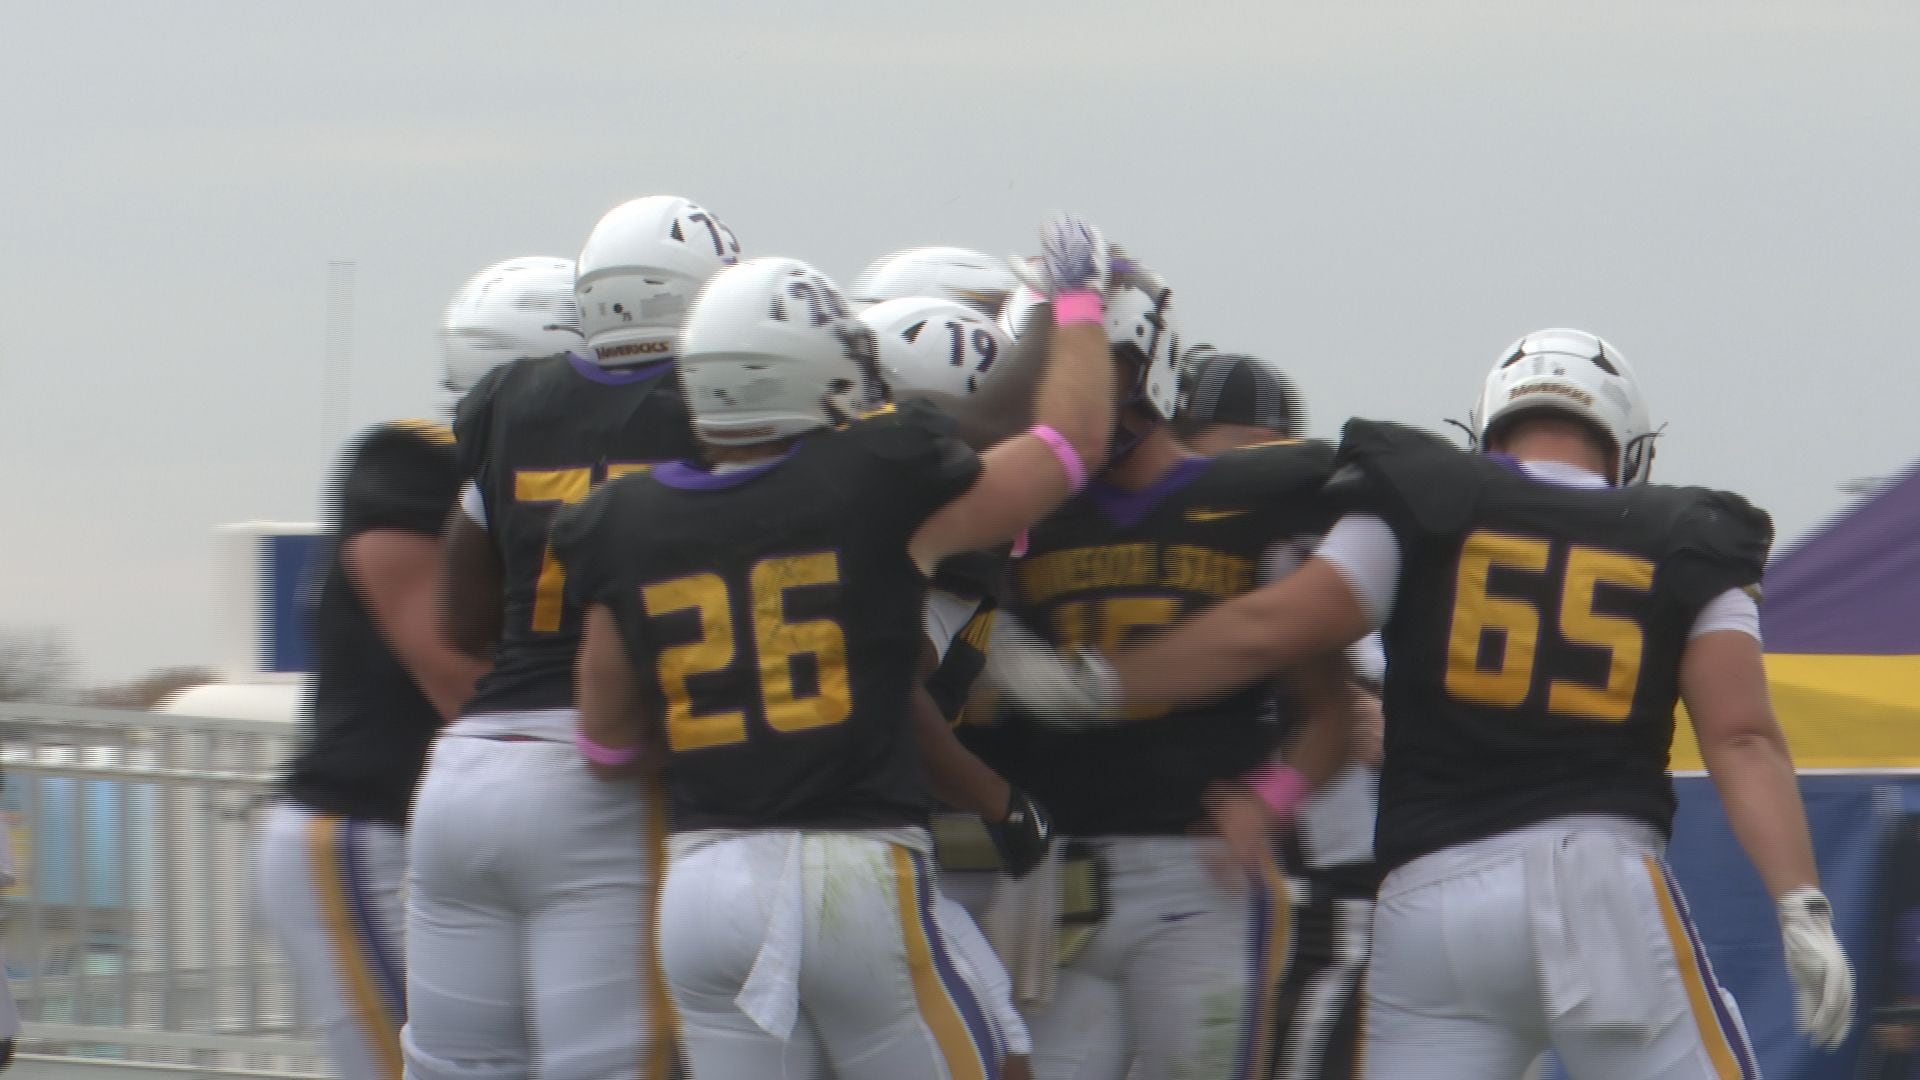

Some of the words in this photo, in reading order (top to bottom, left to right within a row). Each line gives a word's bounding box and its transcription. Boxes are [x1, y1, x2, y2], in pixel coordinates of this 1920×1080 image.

[945, 319, 998, 373] 19
[640, 550, 854, 753] 26
[1445, 529, 1657, 723] 65
